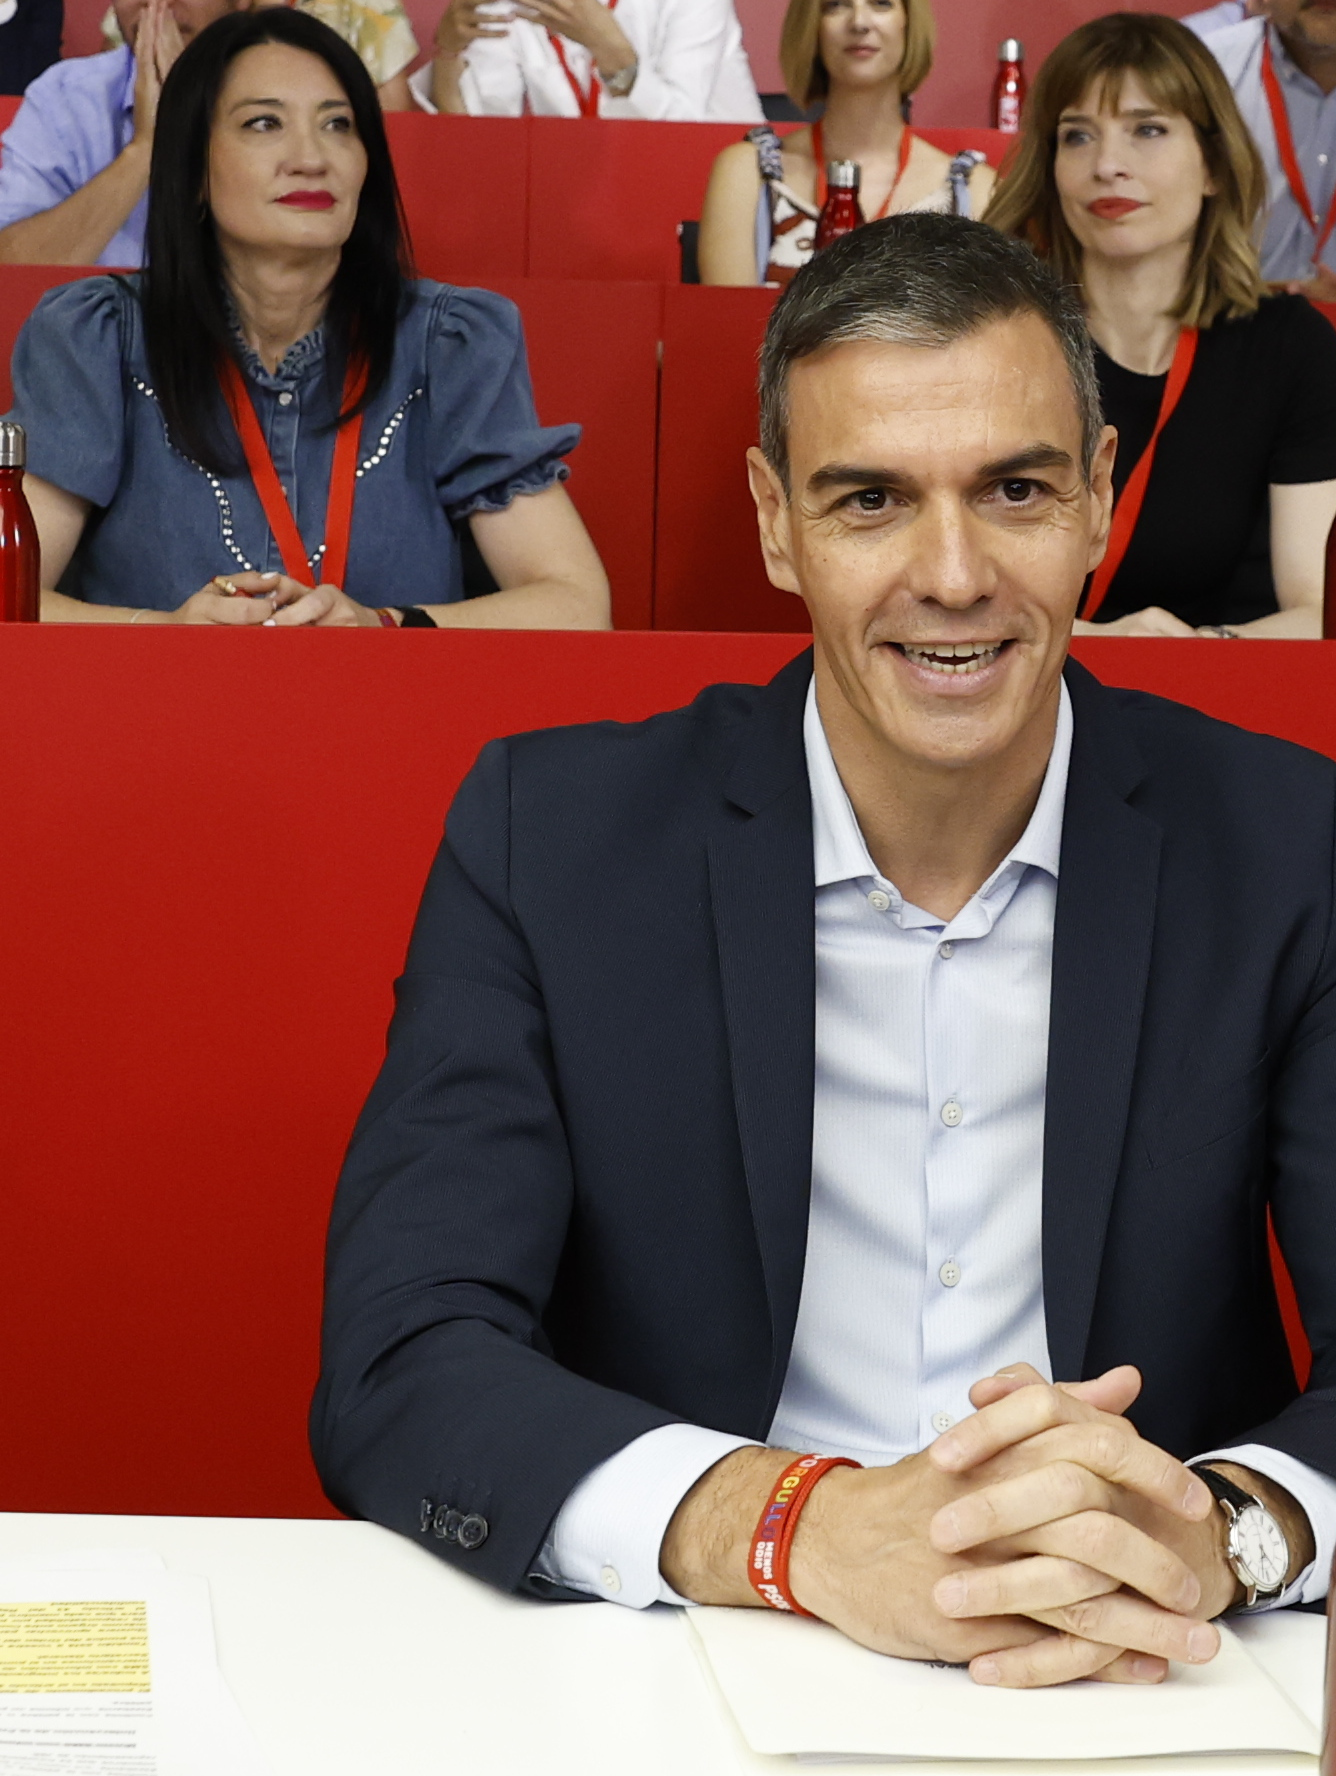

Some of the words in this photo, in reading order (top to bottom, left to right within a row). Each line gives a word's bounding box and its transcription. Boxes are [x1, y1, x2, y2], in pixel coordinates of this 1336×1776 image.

[761, 1459, 819, 1540] ORGULLO
[753, 1541, 766, 1570] ODIO
[763, 1541, 775, 1580] MENOS
